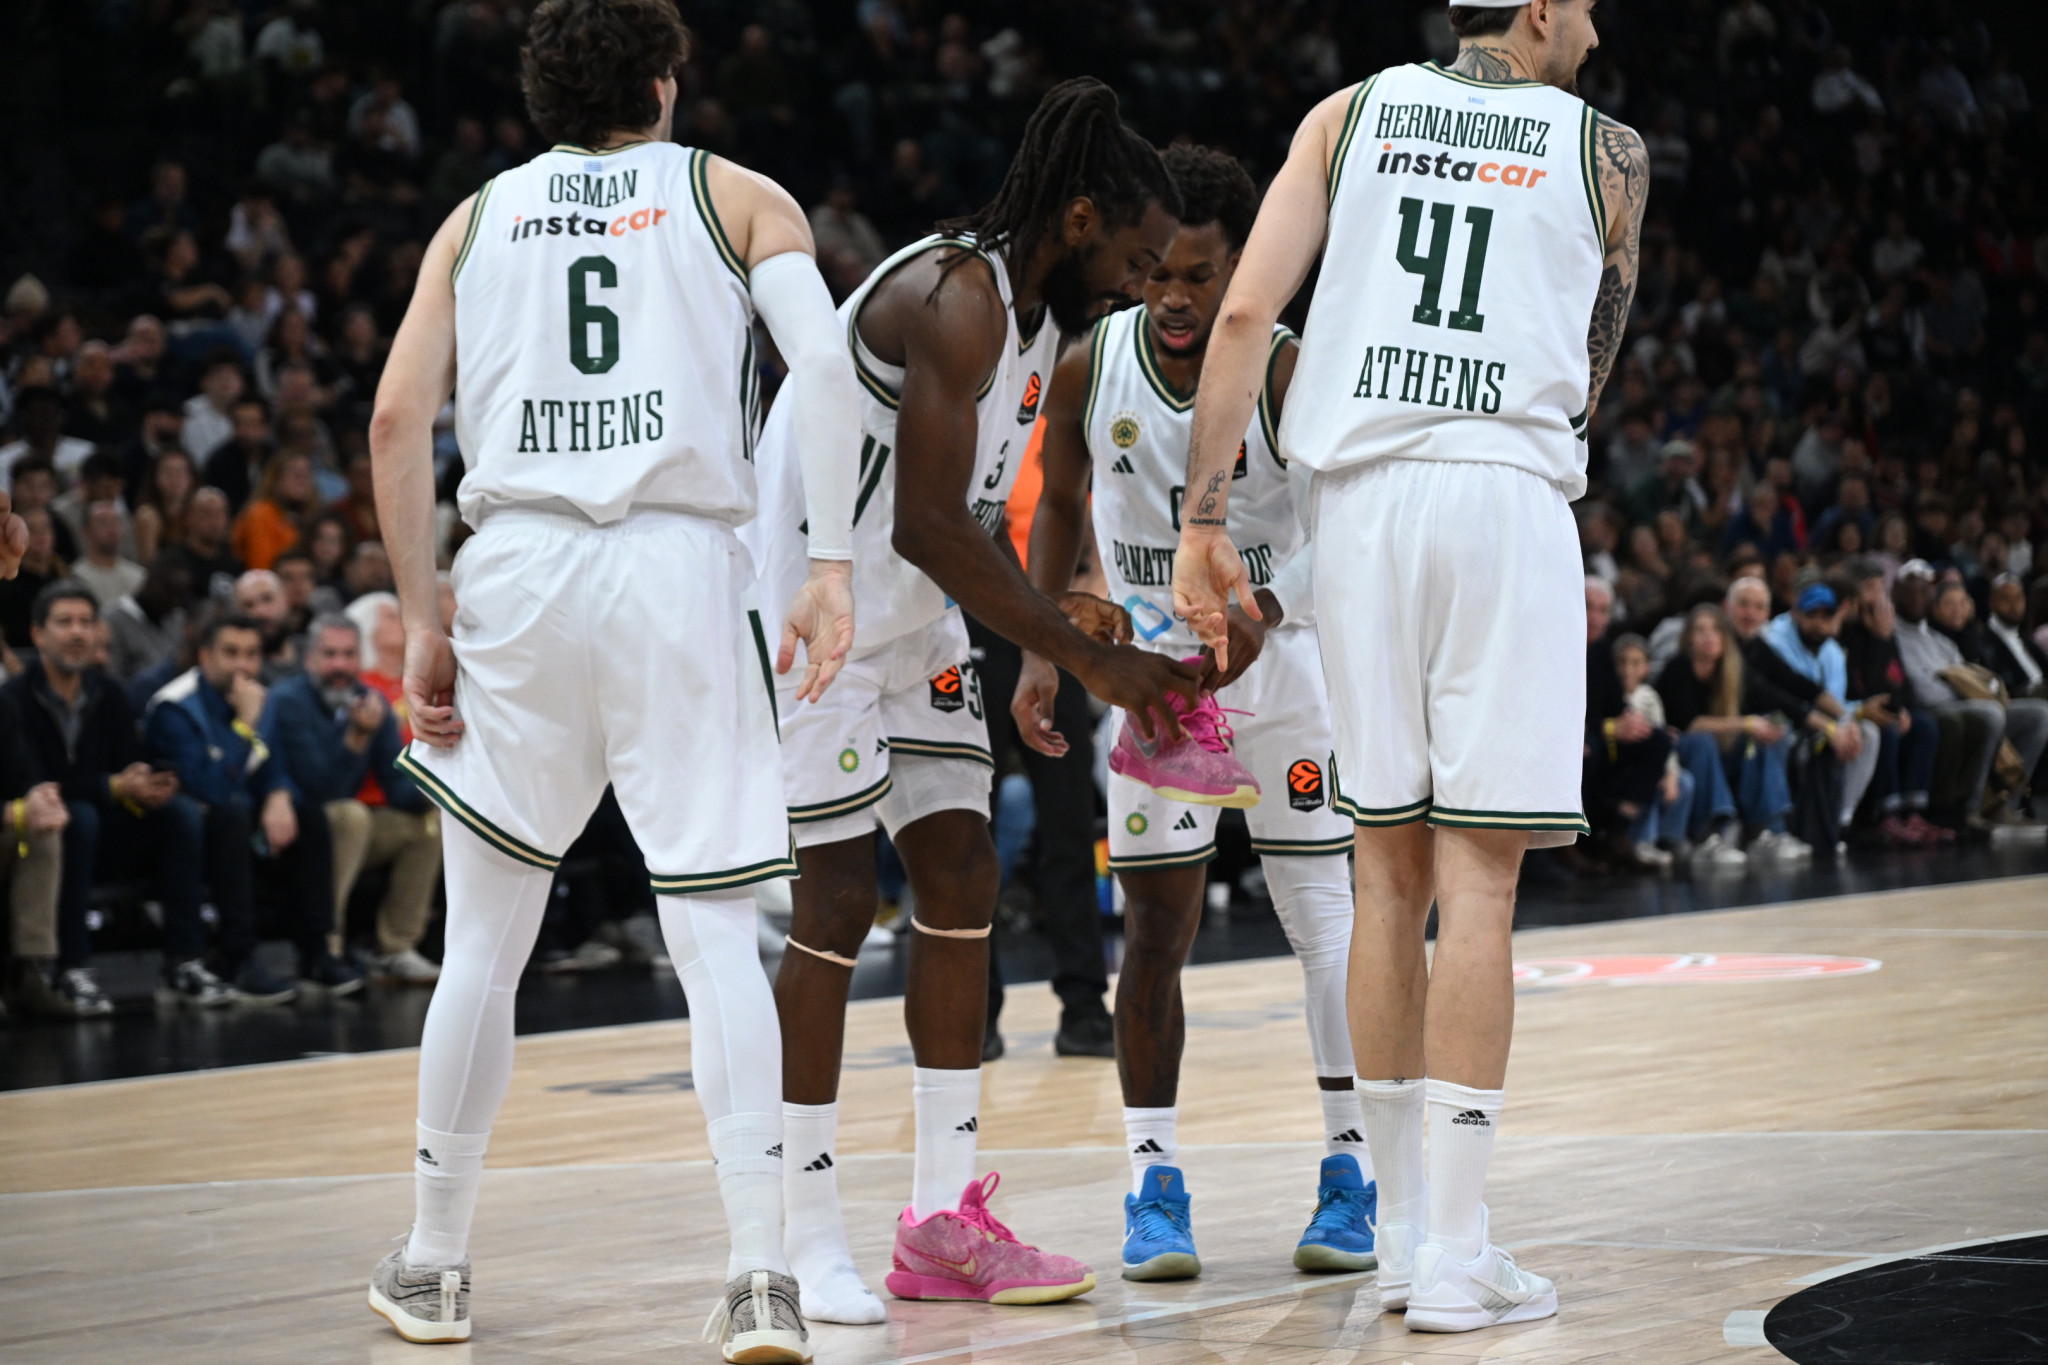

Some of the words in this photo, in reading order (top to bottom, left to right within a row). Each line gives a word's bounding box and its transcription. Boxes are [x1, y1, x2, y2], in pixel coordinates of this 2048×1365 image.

[1375, 102, 1550, 157] HERNANGOMEZ
[549, 169, 638, 208] OSMAN
[1377, 142, 1547, 188] instacar
[510, 207, 667, 242] instacar
[1396, 196, 1494, 333] 41
[568, 255, 619, 375] 6
[1353, 345, 1506, 415] ATHENS
[517, 389, 663, 453] ATHENS
[1452, 1116, 1490, 1126] adidas
